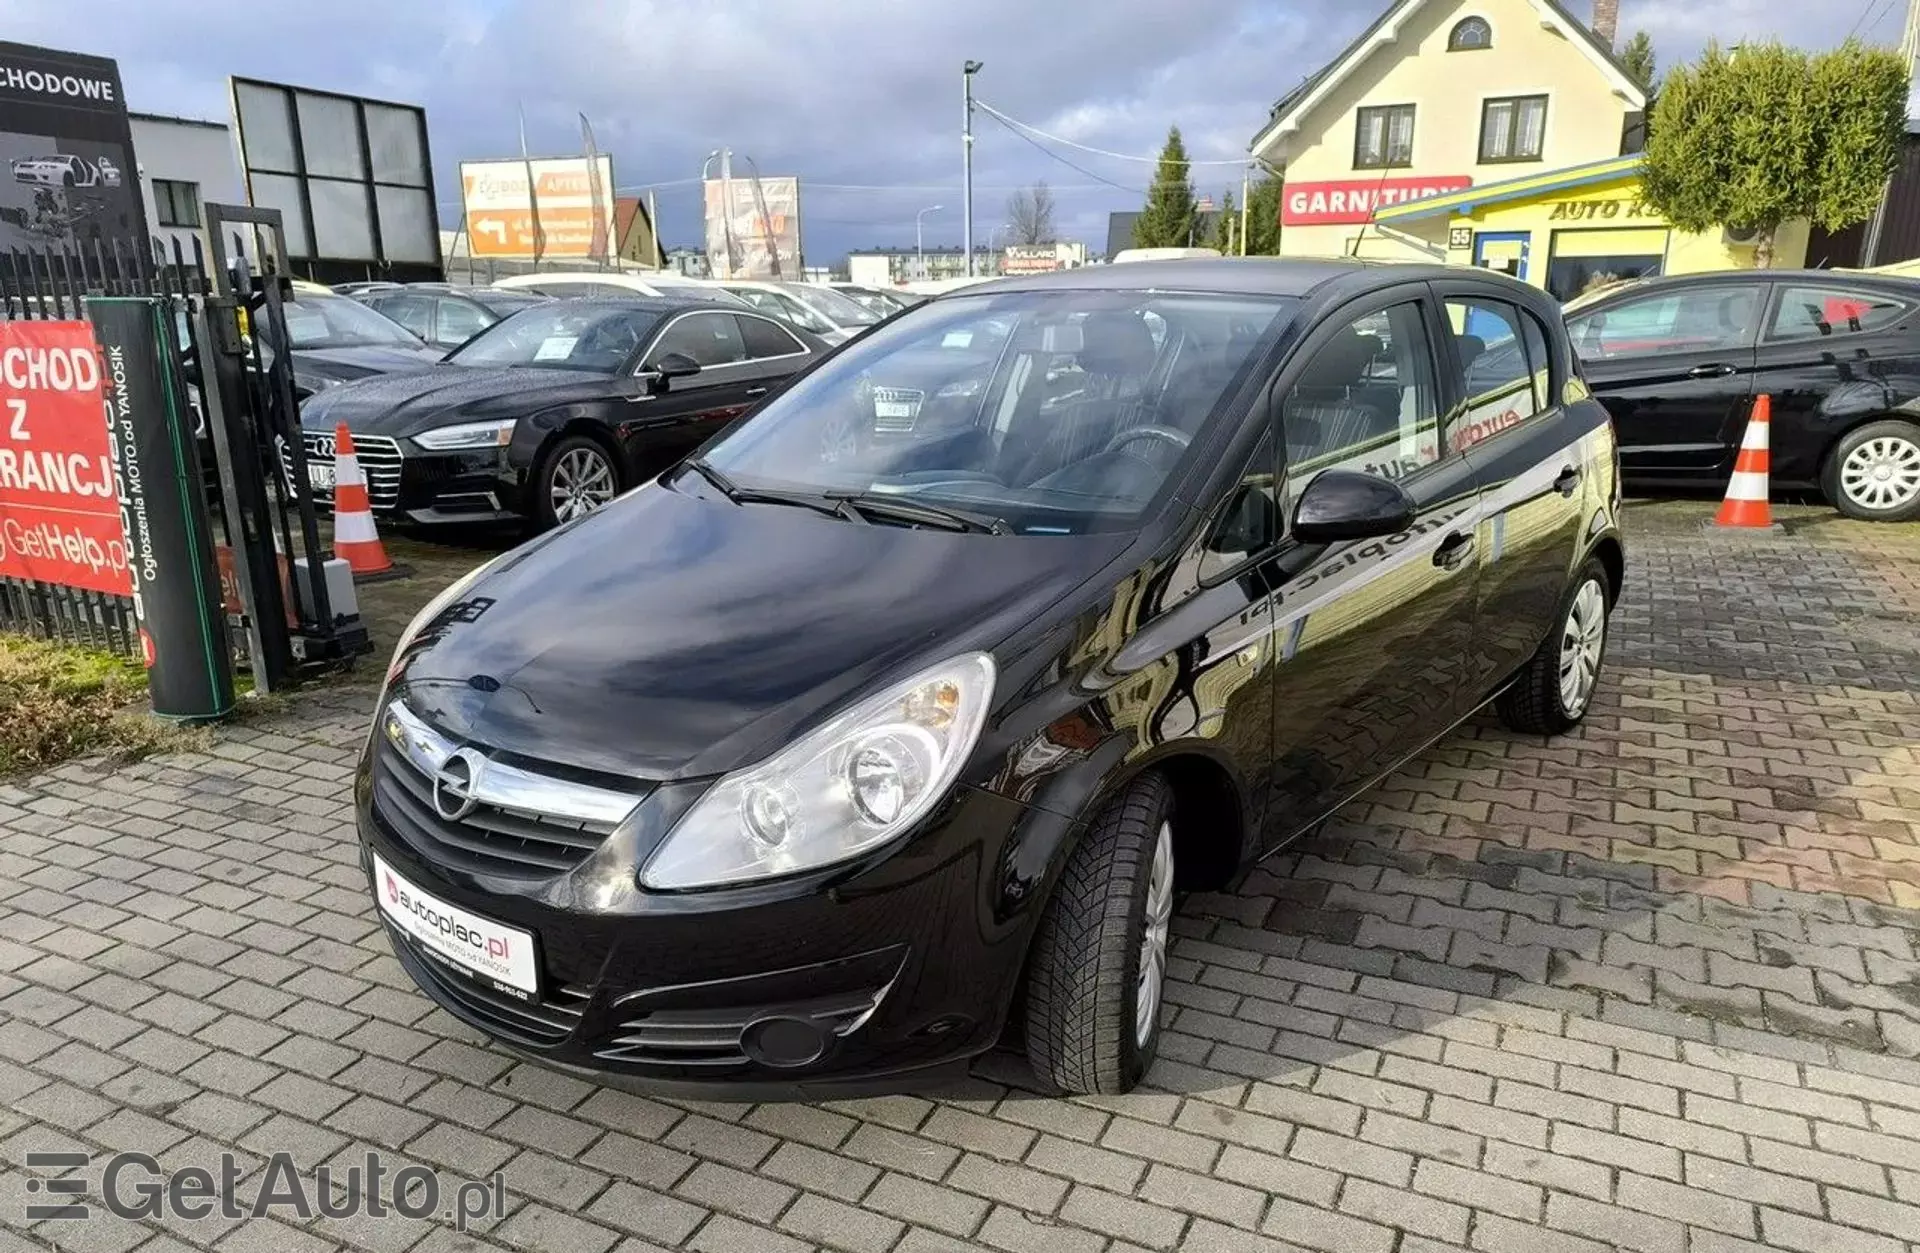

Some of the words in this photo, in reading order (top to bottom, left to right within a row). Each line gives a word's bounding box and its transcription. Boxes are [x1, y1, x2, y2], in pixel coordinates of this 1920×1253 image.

[1290, 186, 1461, 214] GARNITU
[1548, 200, 1620, 220] AUTO
[1452, 229, 1471, 245] 55
[0, 346, 99, 391] CHOD
[110, 345, 130, 416] YANOSIK
[6, 398, 31, 440] Z
[121, 420, 134, 441] od
[0, 448, 113, 498] RANCJ
[125, 444, 143, 493] MOTO
[4, 518, 126, 578] GetHelp.p
[134, 496, 157, 582] Ogłoszenia
[400, 890, 509, 960] autoplac.pl
